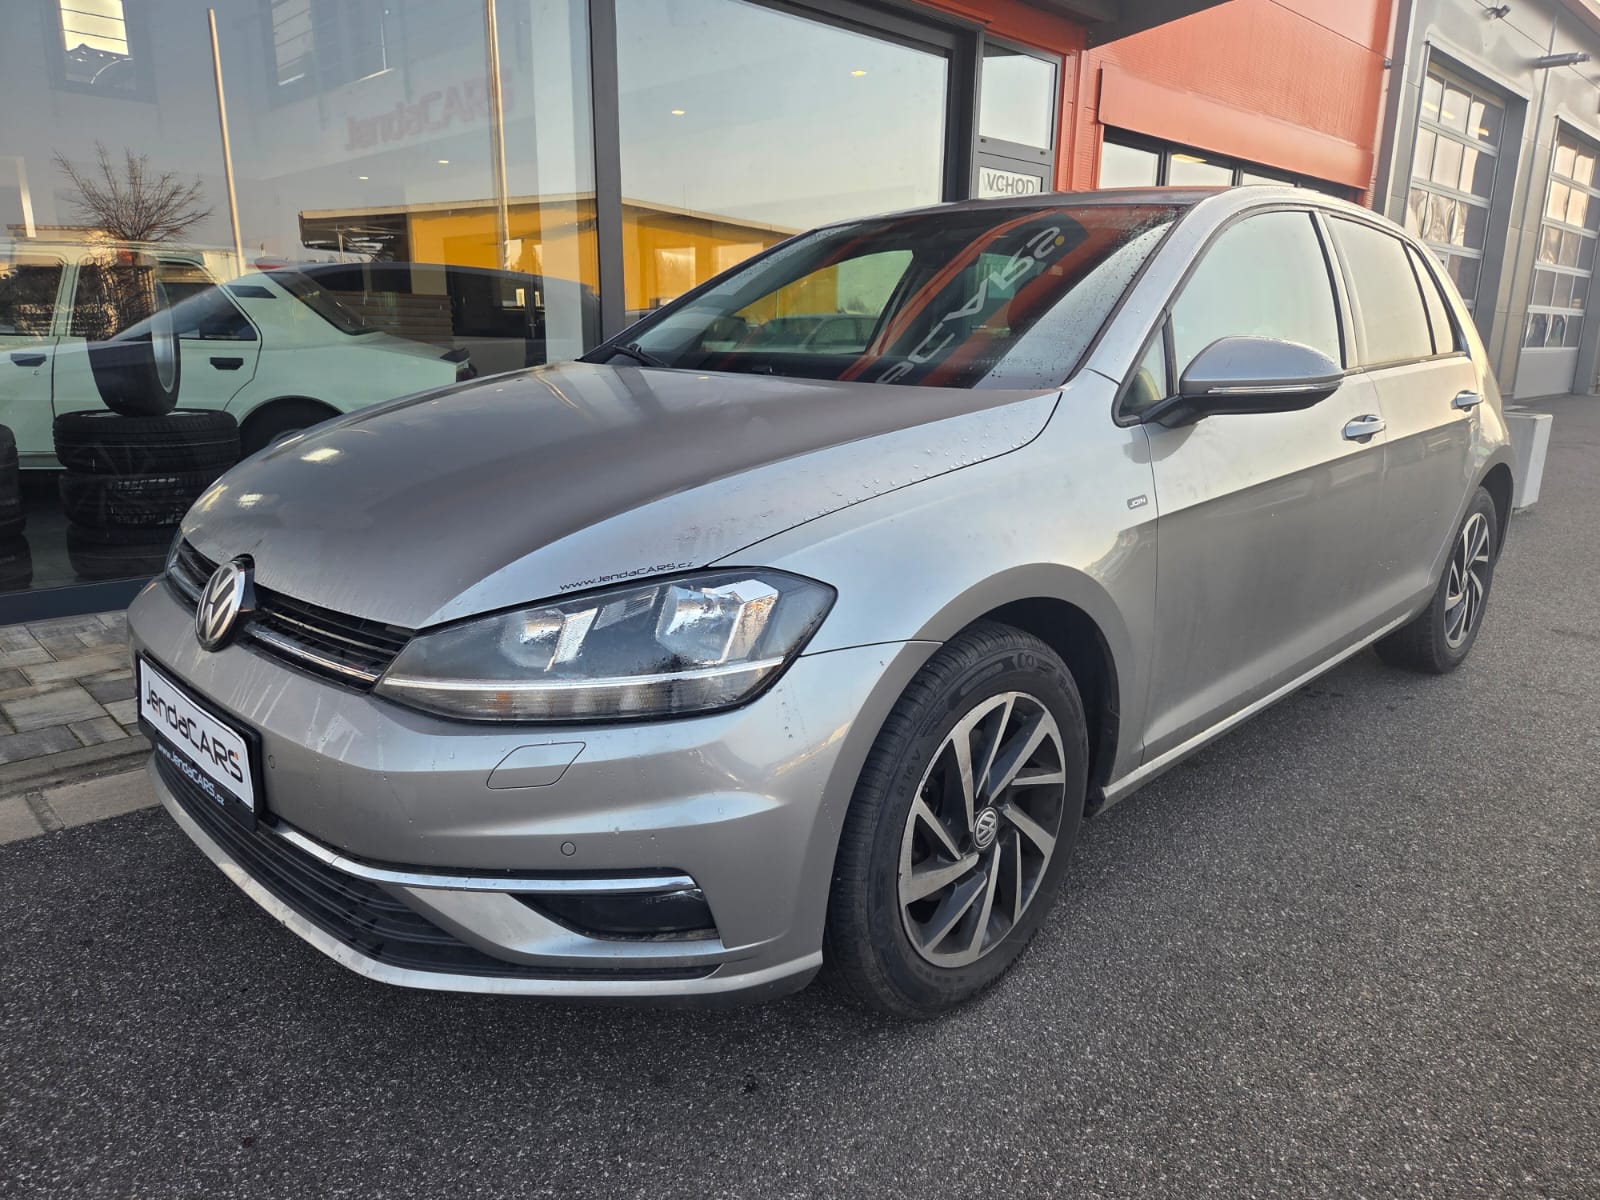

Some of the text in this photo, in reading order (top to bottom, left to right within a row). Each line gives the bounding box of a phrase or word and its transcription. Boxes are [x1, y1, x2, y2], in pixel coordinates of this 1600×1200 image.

[986, 172, 1035, 195] VCHOD
[559, 561, 694, 591] www.JendaCARS.cz
[146, 681, 244, 783] JendaCARS
[157, 742, 225, 806] www.JendaCARS.cz
